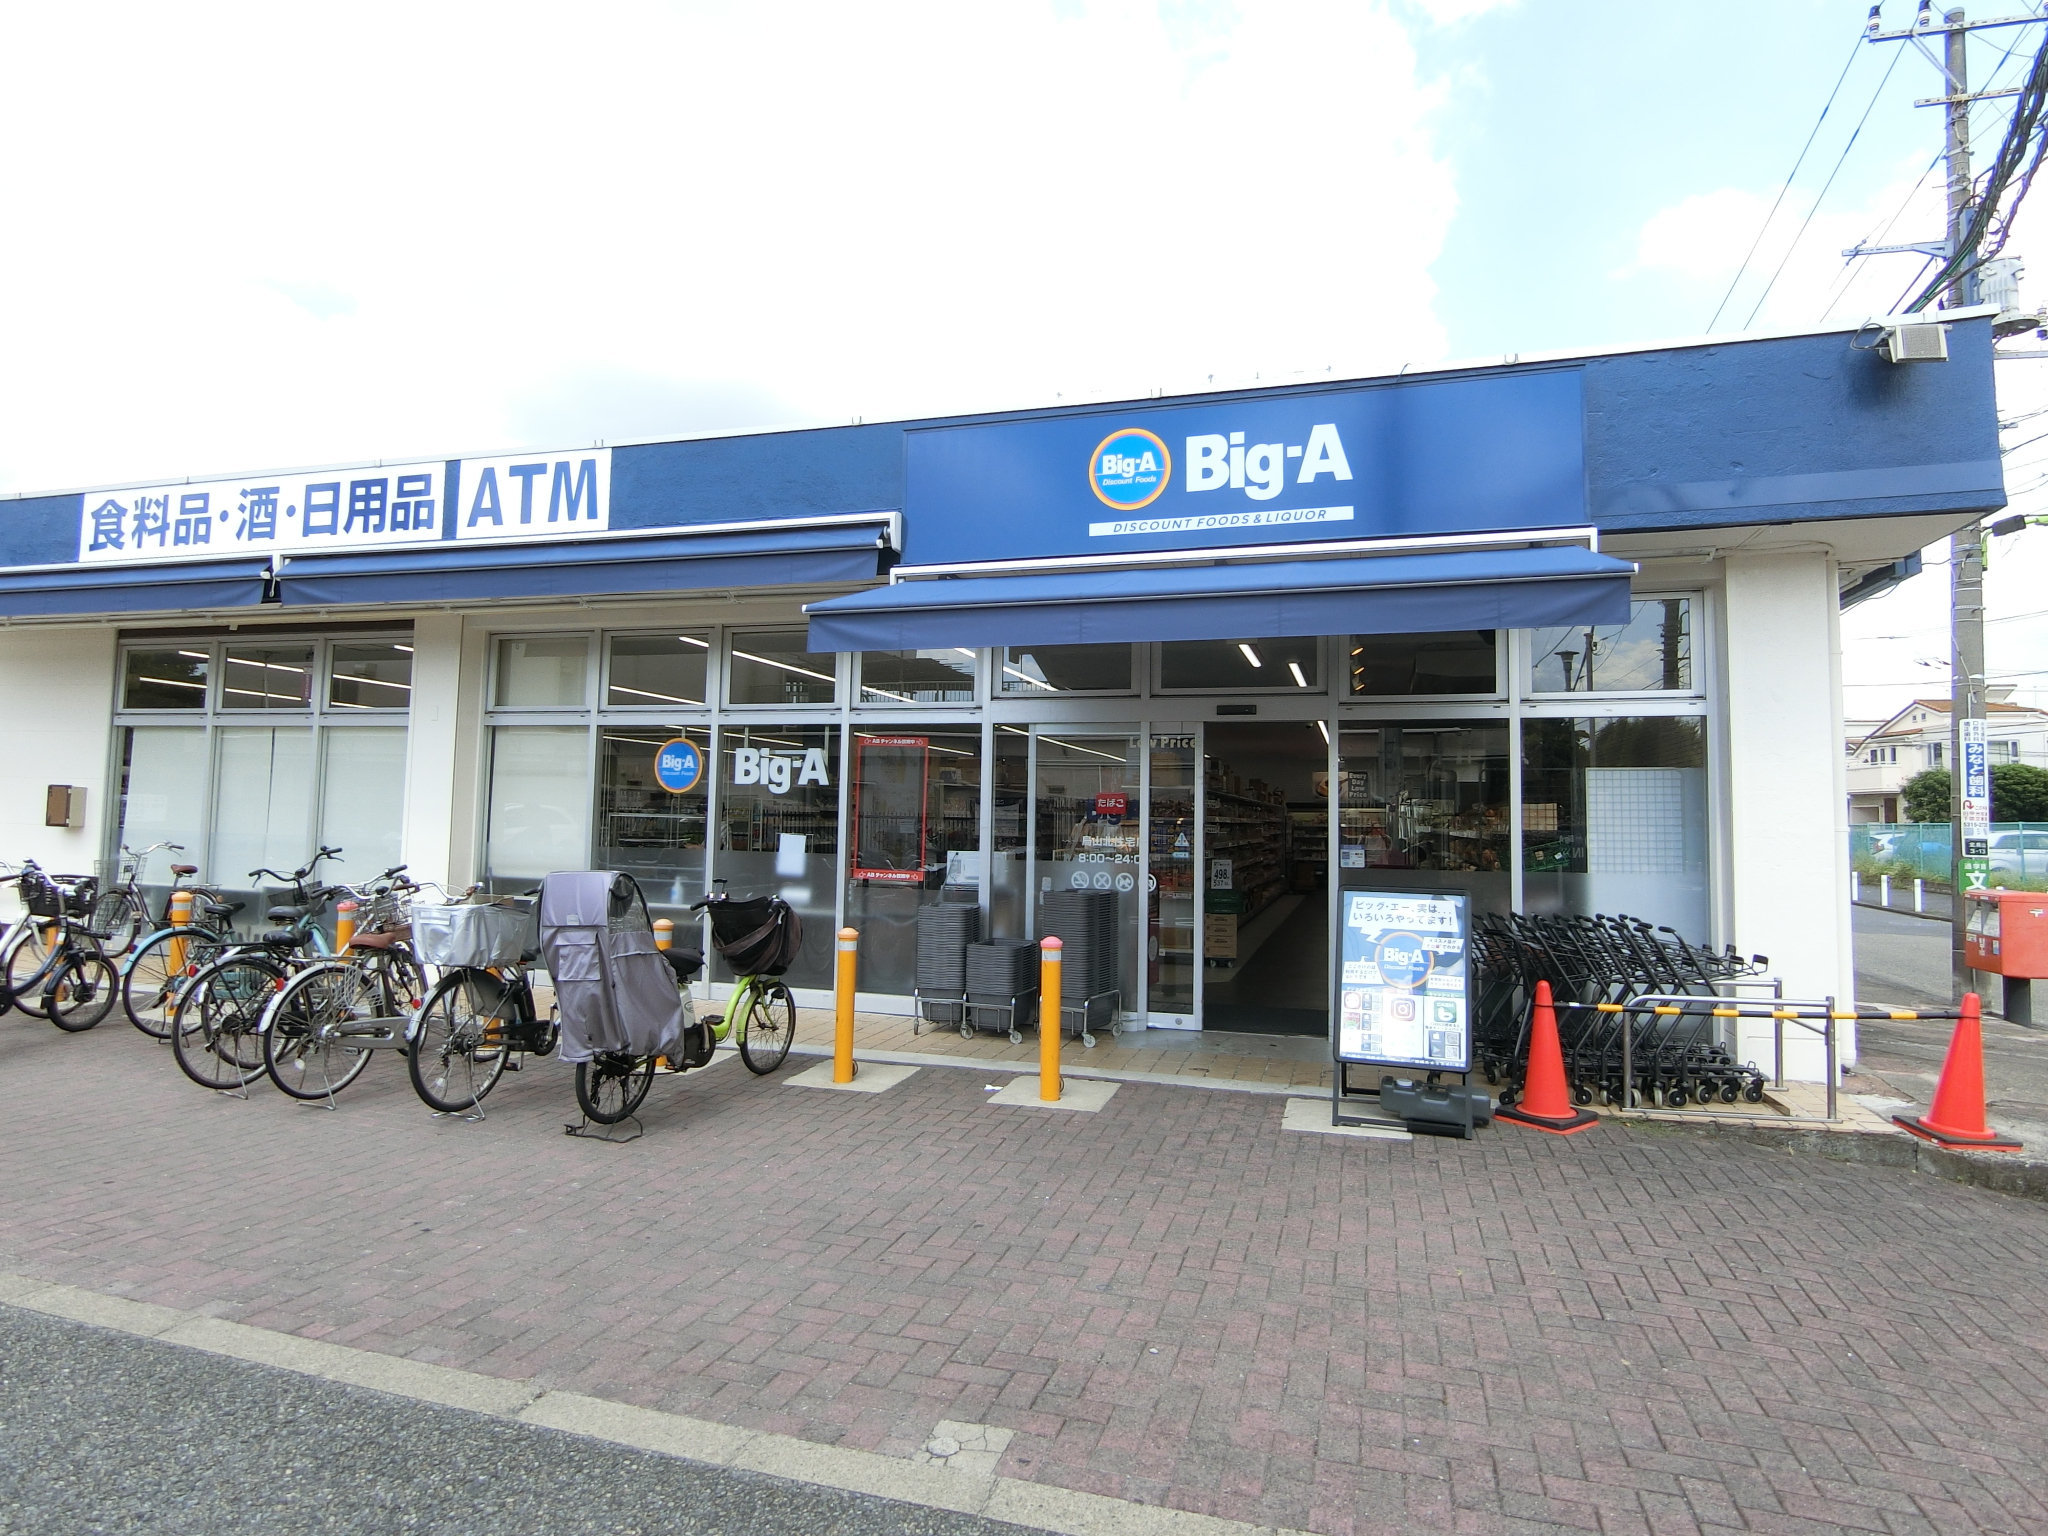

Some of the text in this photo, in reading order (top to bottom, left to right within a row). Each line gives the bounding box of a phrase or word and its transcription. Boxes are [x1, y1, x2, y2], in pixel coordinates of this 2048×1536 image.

[1102, 451, 1157, 477] Big-A
[1186, 423, 1353, 501] Big-A
[1102, 475, 1157, 486] Discount Foods
[467, 459, 598, 528] ATM
[88, 473, 435, 552] 食料品・酒・日用品
[1113, 518, 1193, 533] DISCOUNT
[1197, 514, 1250, 528] FOODS
[1266, 509, 1327, 524] LIQUOR
[662, 754, 695, 771] Big-A
[734, 747, 830, 795] Big-A
[1968, 743, 1984, 797] みなと歯科
[1098, 798, 1124, 808] たばこ
[1214, 868, 1228, 880] 498
[1383, 947, 1425, 966] Big-A
